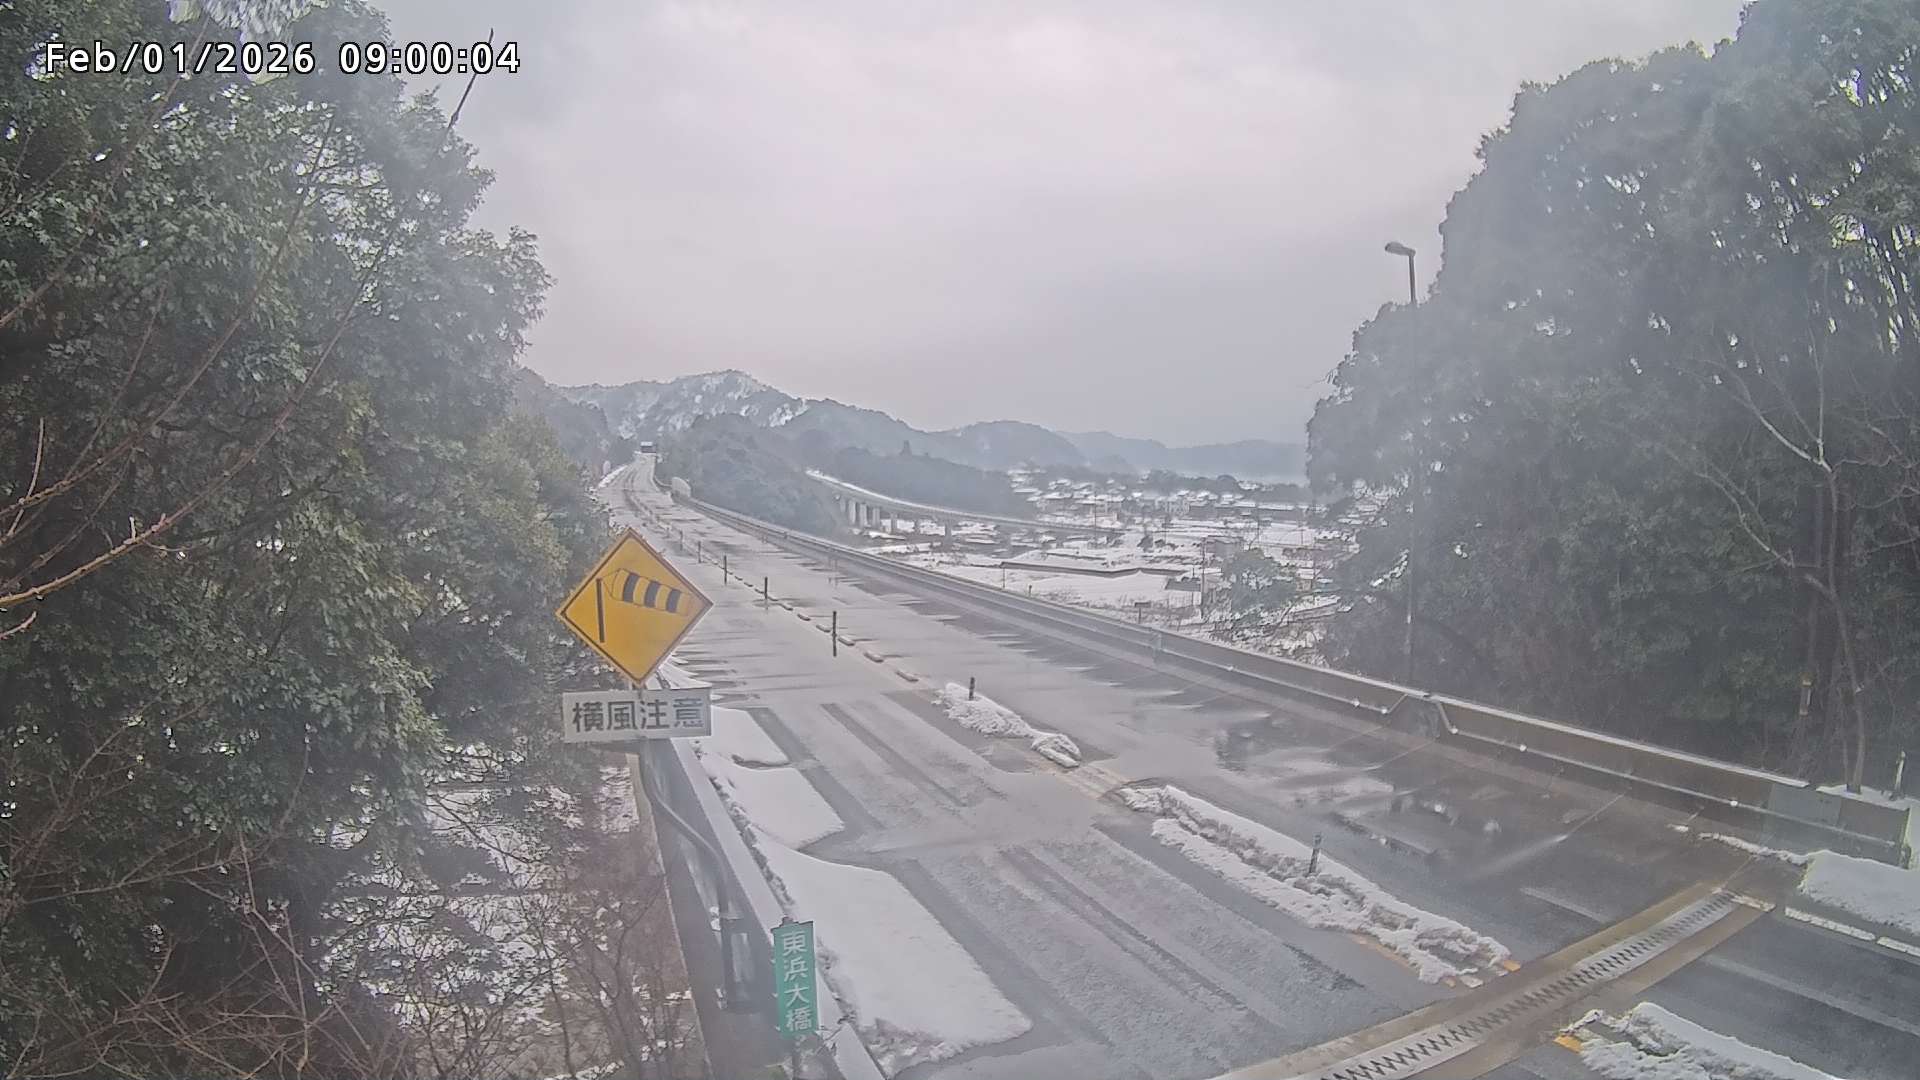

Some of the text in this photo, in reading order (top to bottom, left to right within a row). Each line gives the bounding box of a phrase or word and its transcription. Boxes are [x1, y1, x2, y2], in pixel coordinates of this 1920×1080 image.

[572, 697, 704, 732] 横風注意
[781, 930, 813, 1032] 東浜大橋
